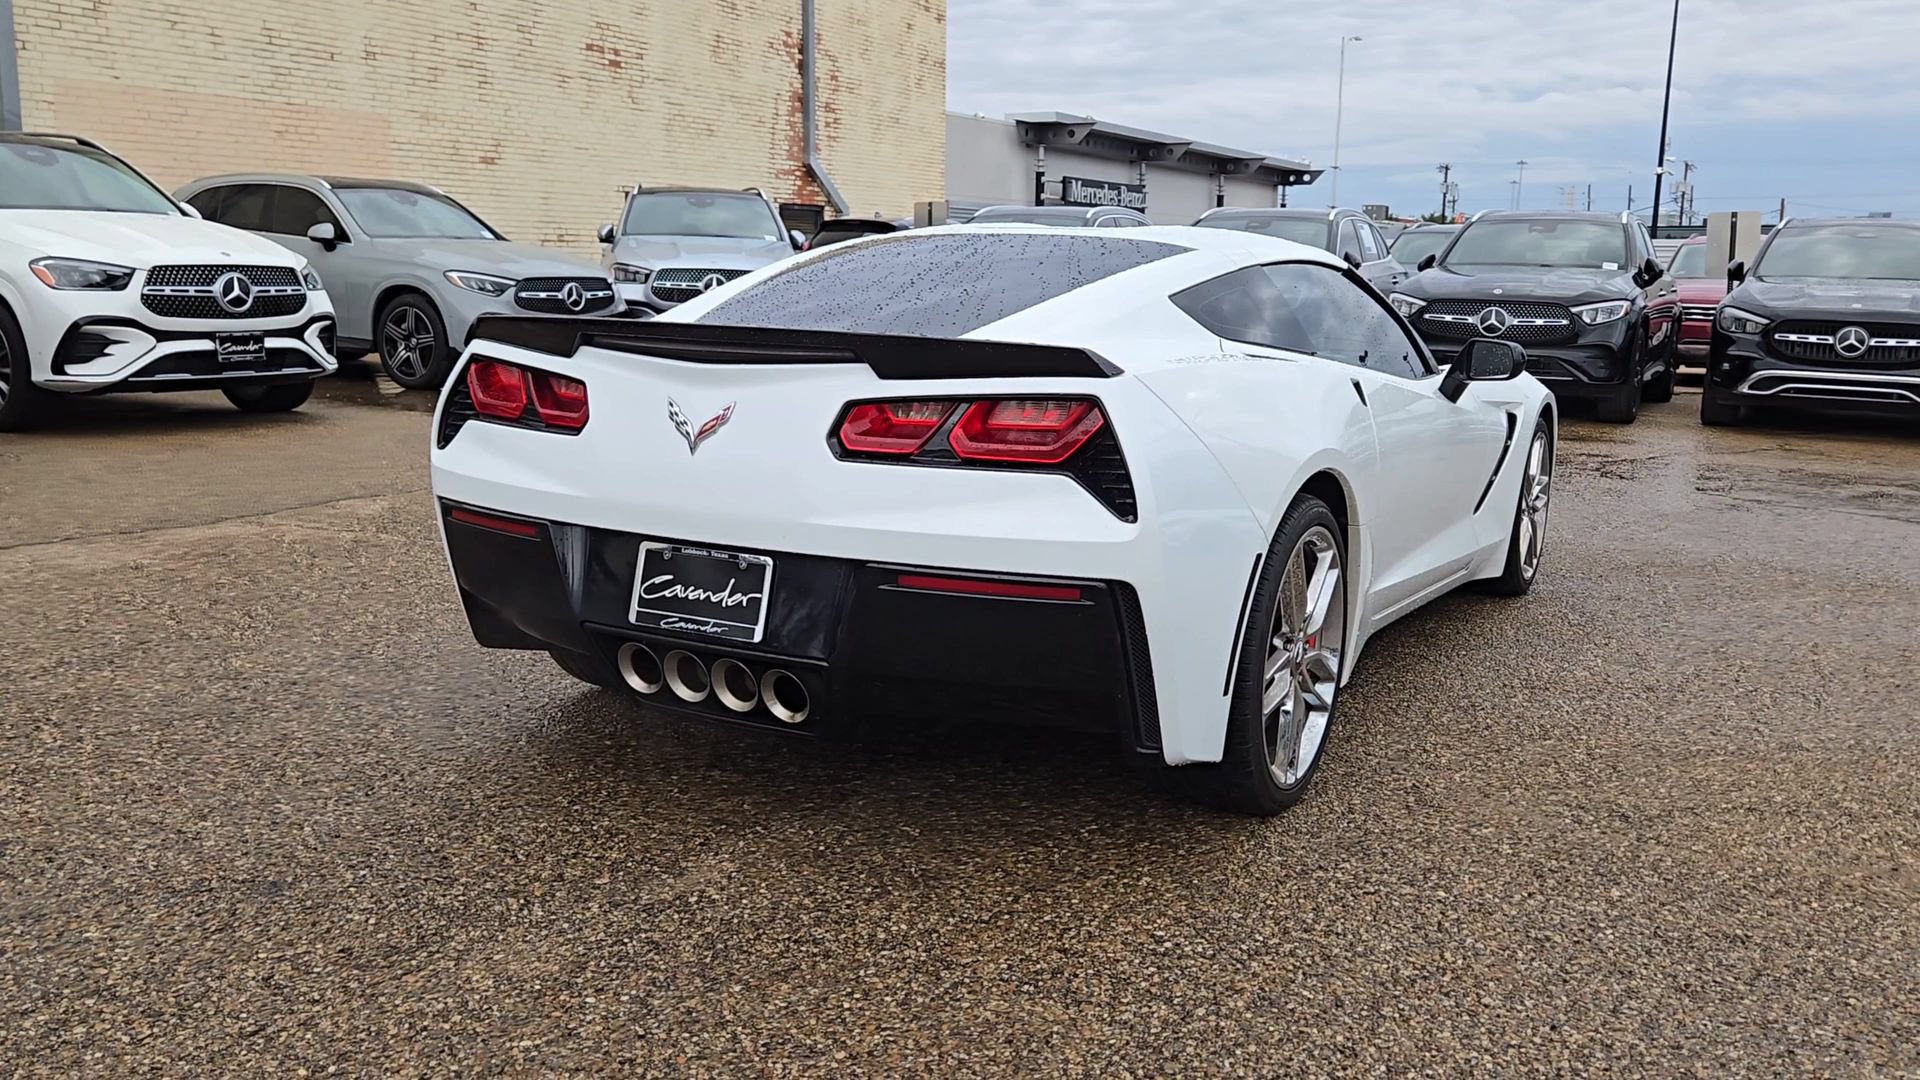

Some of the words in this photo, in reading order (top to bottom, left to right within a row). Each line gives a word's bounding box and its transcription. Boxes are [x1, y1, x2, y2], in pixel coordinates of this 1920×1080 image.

[1071, 179, 1145, 208] Mercedes-Benz
[711, 550, 729, 559] Texas
[640, 575, 762, 608] Cavender
[660, 617, 729, 634] Cavender
